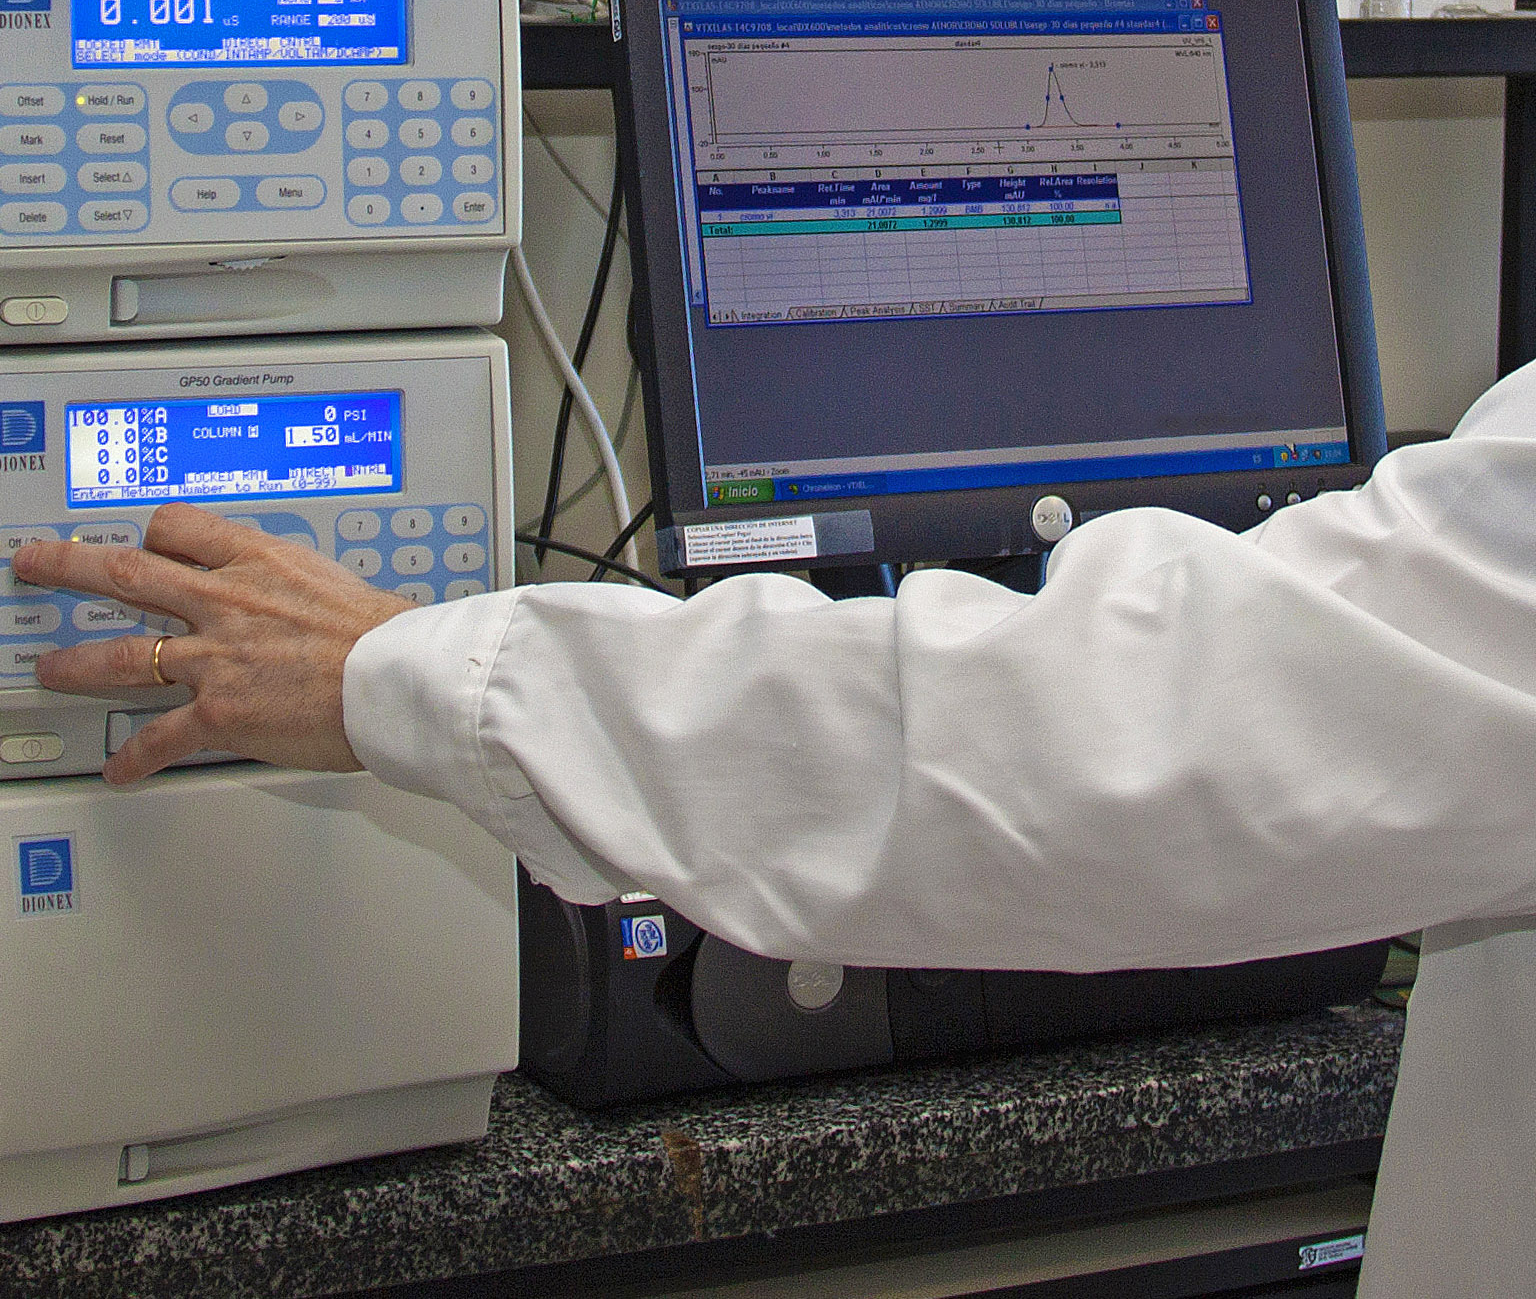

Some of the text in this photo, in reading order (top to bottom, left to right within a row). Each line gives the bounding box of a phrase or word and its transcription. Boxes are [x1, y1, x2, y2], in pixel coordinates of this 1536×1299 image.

[271, 15, 311, 26] RANGE
[17, 95, 44, 106] Offset
[88, 94, 134, 106] Hold Run
[21, 134, 43, 145] Mark
[100, 133, 125, 144] Reset
[20, 173, 46, 183] Insert
[93, 171, 120, 183] Select
[197, 189, 217, 200] Help
[279, 187, 303, 198] Menu
[464, 201, 485, 213] Enter
[19, 211, 47, 223] Delete
[94, 210, 121, 221] Select
[180, 374, 294, 387] GP50 Gradient Pump
[72, 408, 167, 427] 100.0 %A
[344, 410, 367, 421] PSI
[98, 427, 167, 444] 0.0 %B
[193, 427, 242, 438] COLUMN
[287, 427, 391, 444] 1.50 mL/MIN
[98, 447, 168, 464] 0.0 %C
[98, 467, 168, 484] 0.0 %D
[71, 489, 112, 500] Enter
[121, 486, 170, 497] Method
[178, 483, 225, 494] Number
[235, 482, 249, 492] to
[259, 480, 282, 491] Run
[22, 893, 72, 913] DIONEX
